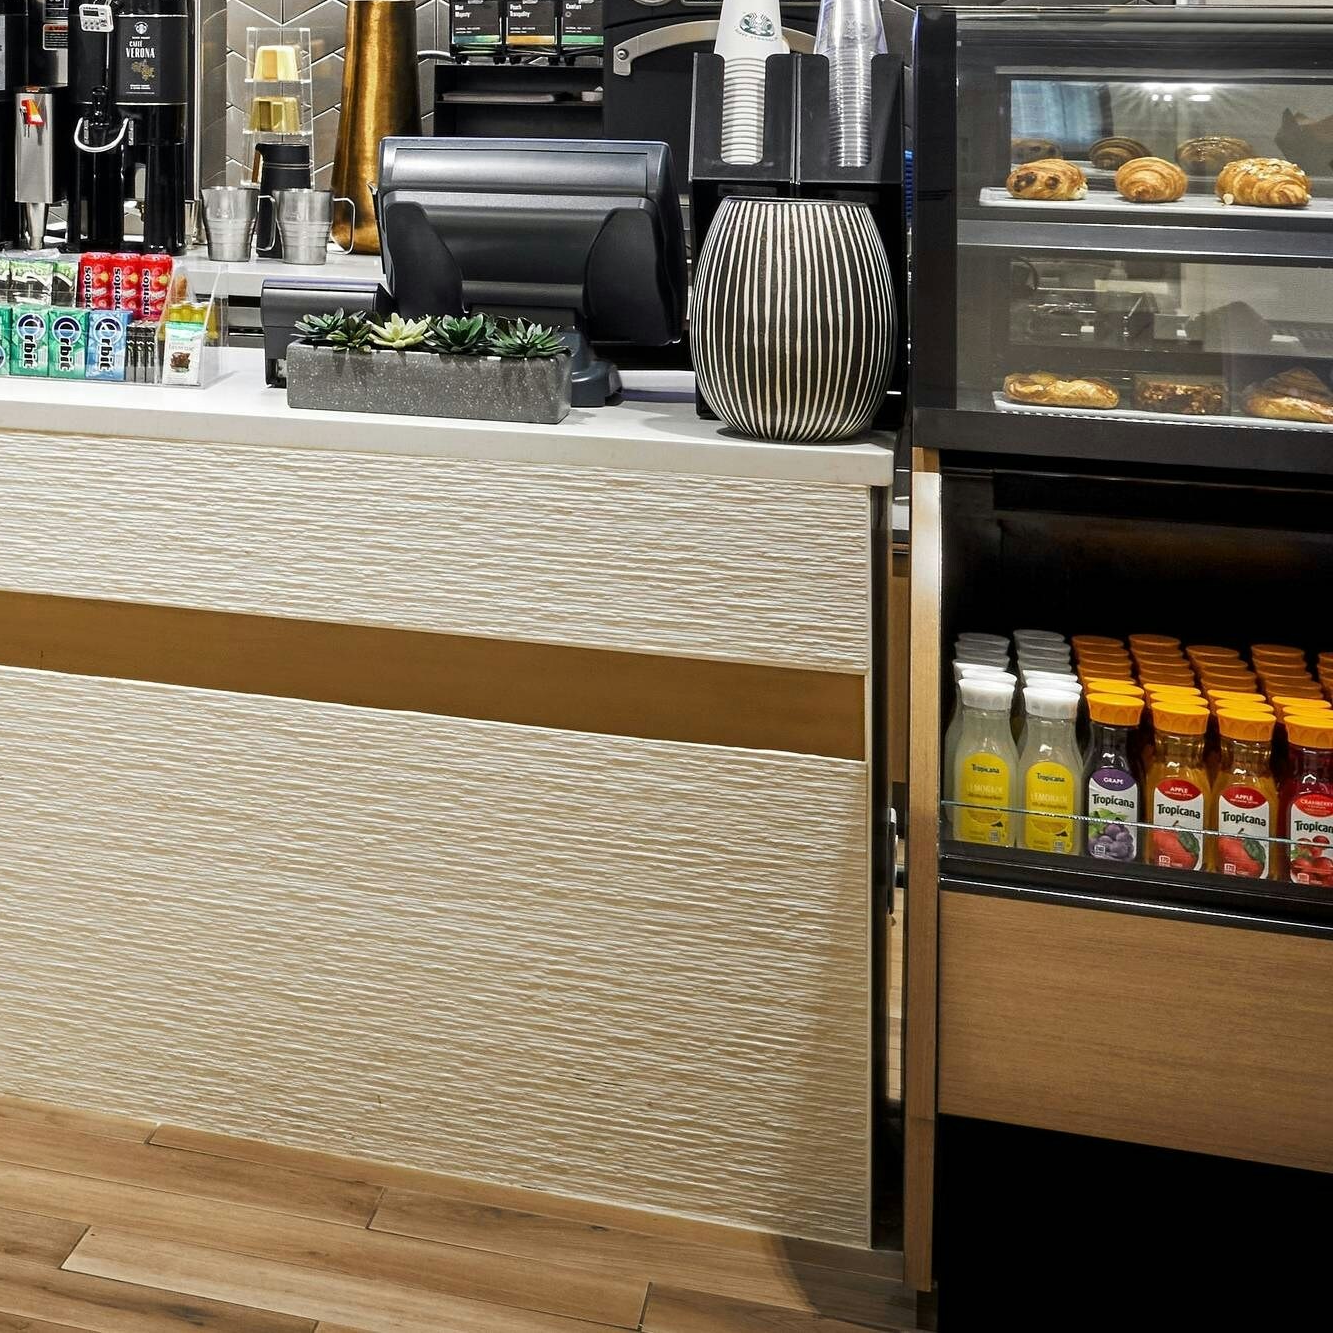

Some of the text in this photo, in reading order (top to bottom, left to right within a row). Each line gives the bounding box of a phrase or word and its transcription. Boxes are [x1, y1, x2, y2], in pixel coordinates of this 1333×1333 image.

[125, 47, 156, 58] VERONA
[142, 269, 150, 316] mentos
[1103, 777, 1124, 785] GRAPE
[1092, 794, 1135, 809] Tropicana
[1157, 804, 1201, 819] Tropicana
[1222, 811, 1267, 826] Tropicana
[1294, 820, 1333, 834] Tropican
